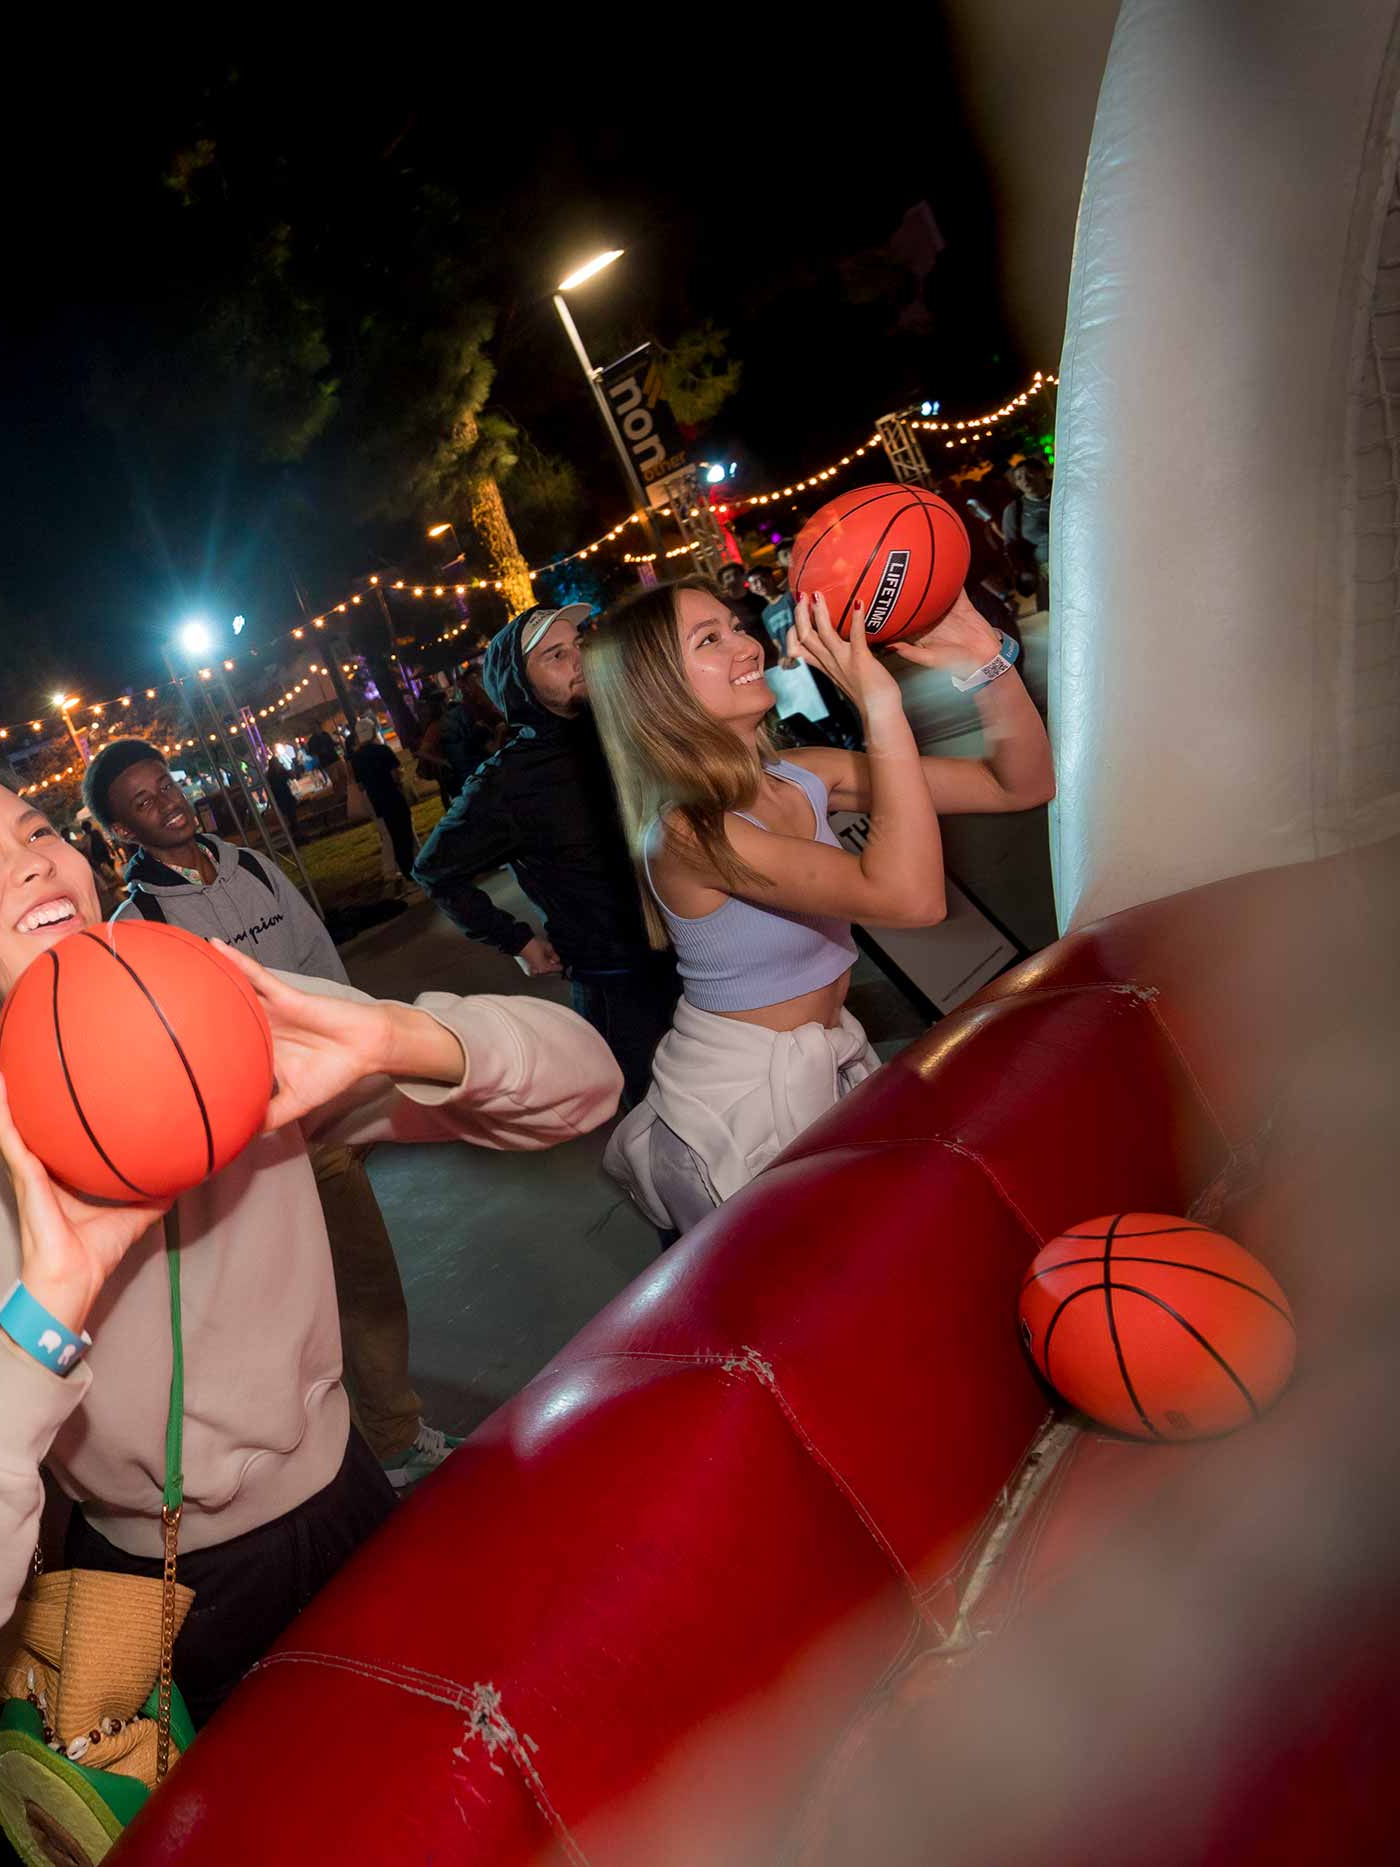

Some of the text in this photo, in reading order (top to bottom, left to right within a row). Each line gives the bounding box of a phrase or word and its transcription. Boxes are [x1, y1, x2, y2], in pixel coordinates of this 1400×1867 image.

[609, 376, 666, 472] non
[867, 562, 904, 628] LIFETIME
[839, 812, 871, 852] TH
[204, 914, 284, 944] mpion
